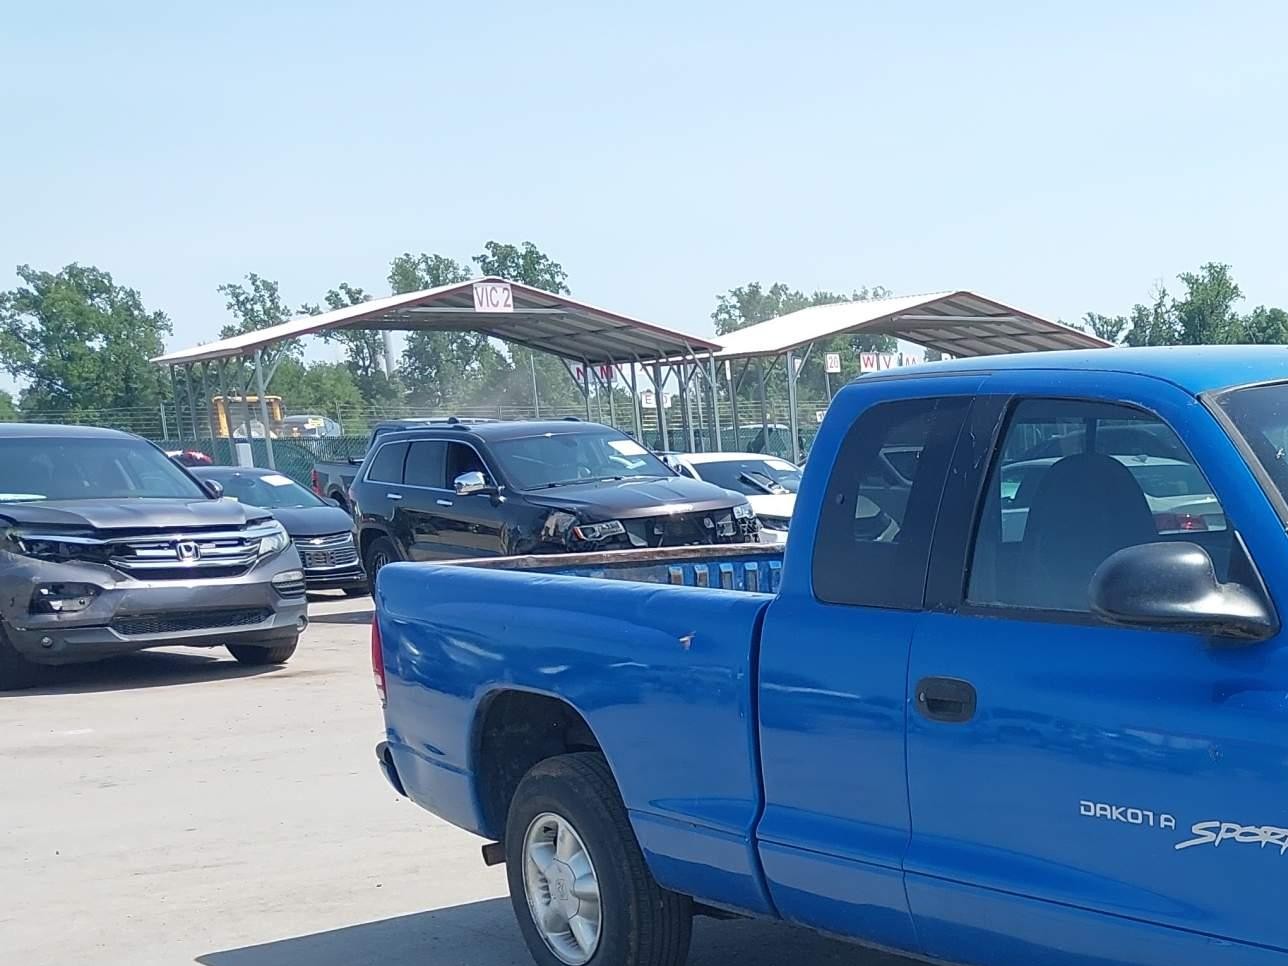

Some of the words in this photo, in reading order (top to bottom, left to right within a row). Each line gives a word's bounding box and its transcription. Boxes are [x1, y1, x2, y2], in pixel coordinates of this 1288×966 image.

[474, 286, 500, 308] VIC
[502, 287, 511, 308] 2
[862, 355, 875, 369] W
[1080, 800, 1176, 830] DAKOTA
